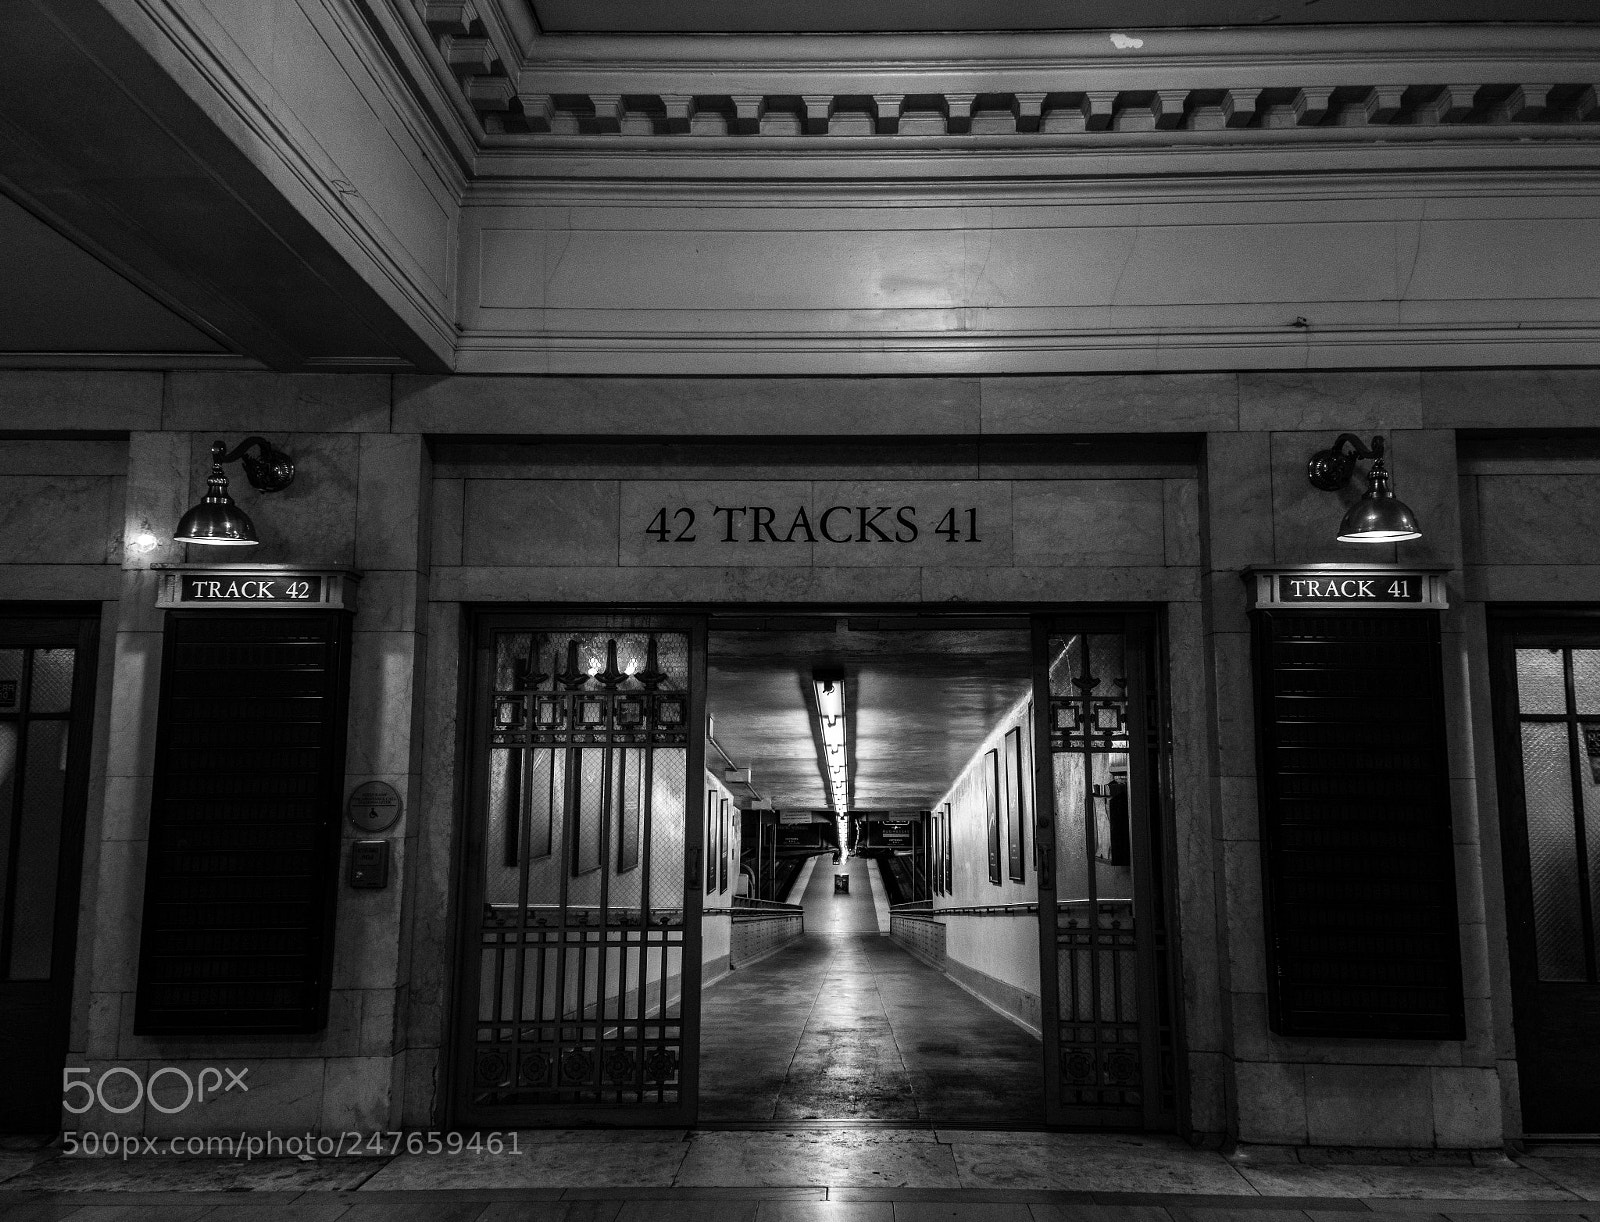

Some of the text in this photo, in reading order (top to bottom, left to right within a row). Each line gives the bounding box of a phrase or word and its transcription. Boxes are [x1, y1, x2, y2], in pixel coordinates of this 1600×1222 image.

[645, 505, 982, 543] 42 TRACKS 41
[191, 580, 310, 599] TRACK 42
[1290, 579, 1411, 598] TRACK 41
